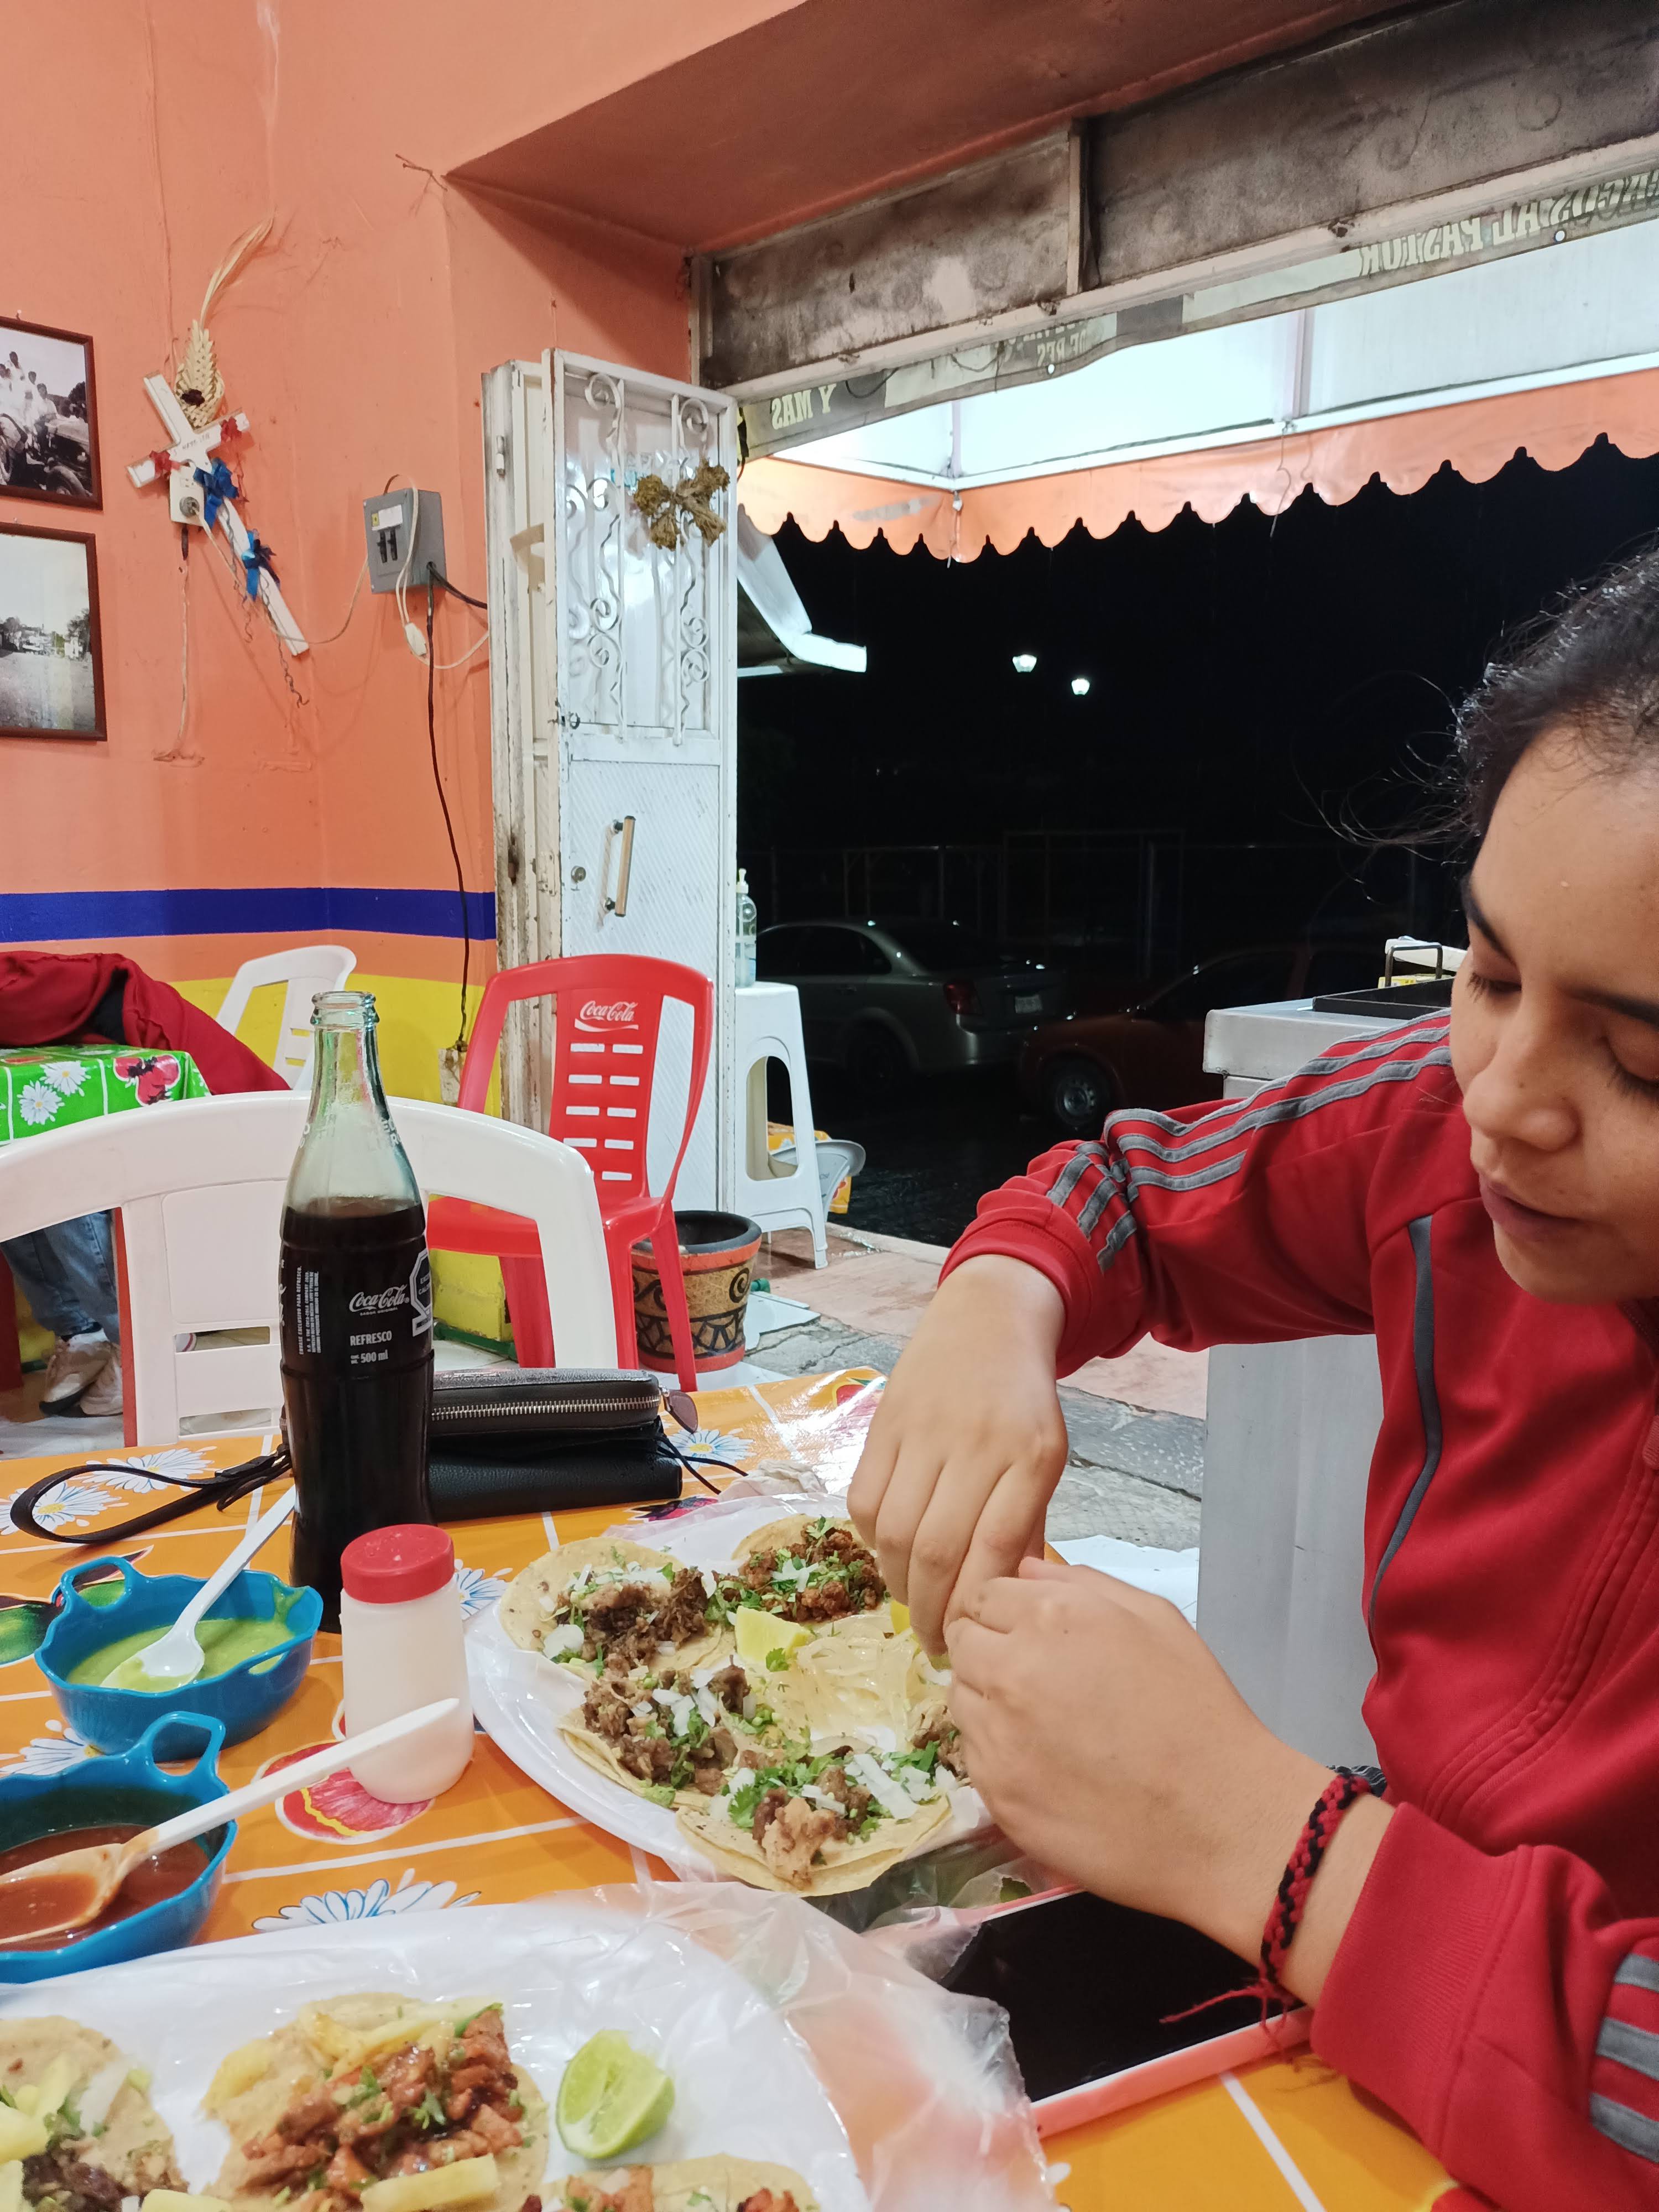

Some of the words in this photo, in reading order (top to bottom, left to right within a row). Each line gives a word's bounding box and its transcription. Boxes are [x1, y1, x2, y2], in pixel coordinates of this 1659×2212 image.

[580, 1000, 638, 1021] Coca-Cola
[349, 1330, 392, 1346] REFRESCO
[361, 1352, 377, 1363] 500
[378, 1349, 388, 1361] ml
